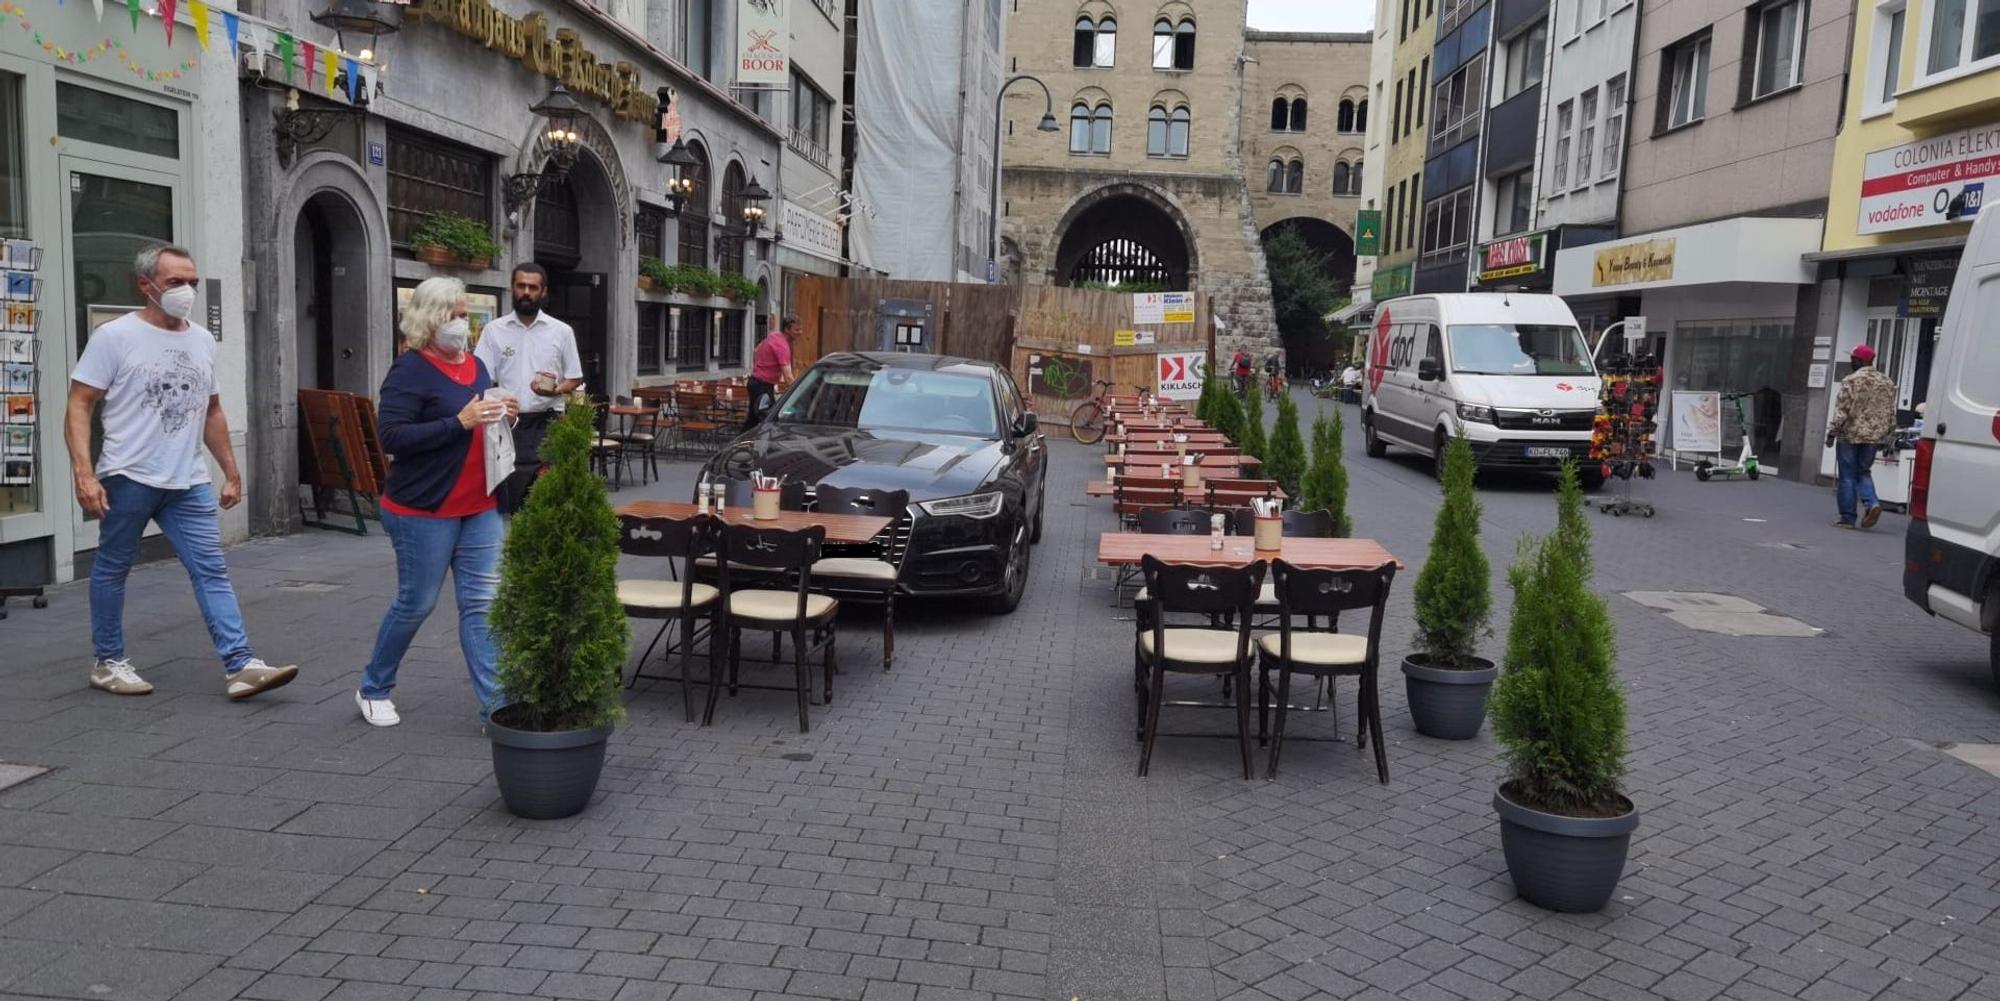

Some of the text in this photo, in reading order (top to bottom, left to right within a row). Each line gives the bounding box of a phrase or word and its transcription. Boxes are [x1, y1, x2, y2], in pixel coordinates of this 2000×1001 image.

[742, 58, 784, 72] BOOR
[1894, 139, 1954, 169] COLONIA
[1907, 167, 1951, 187] Computer
[1868, 202, 1925, 225] vodafone
[1910, 286, 1949, 298] MONTAGE
[1390, 323, 1417, 376] dpd
[1532, 417, 1561, 425] MAN
